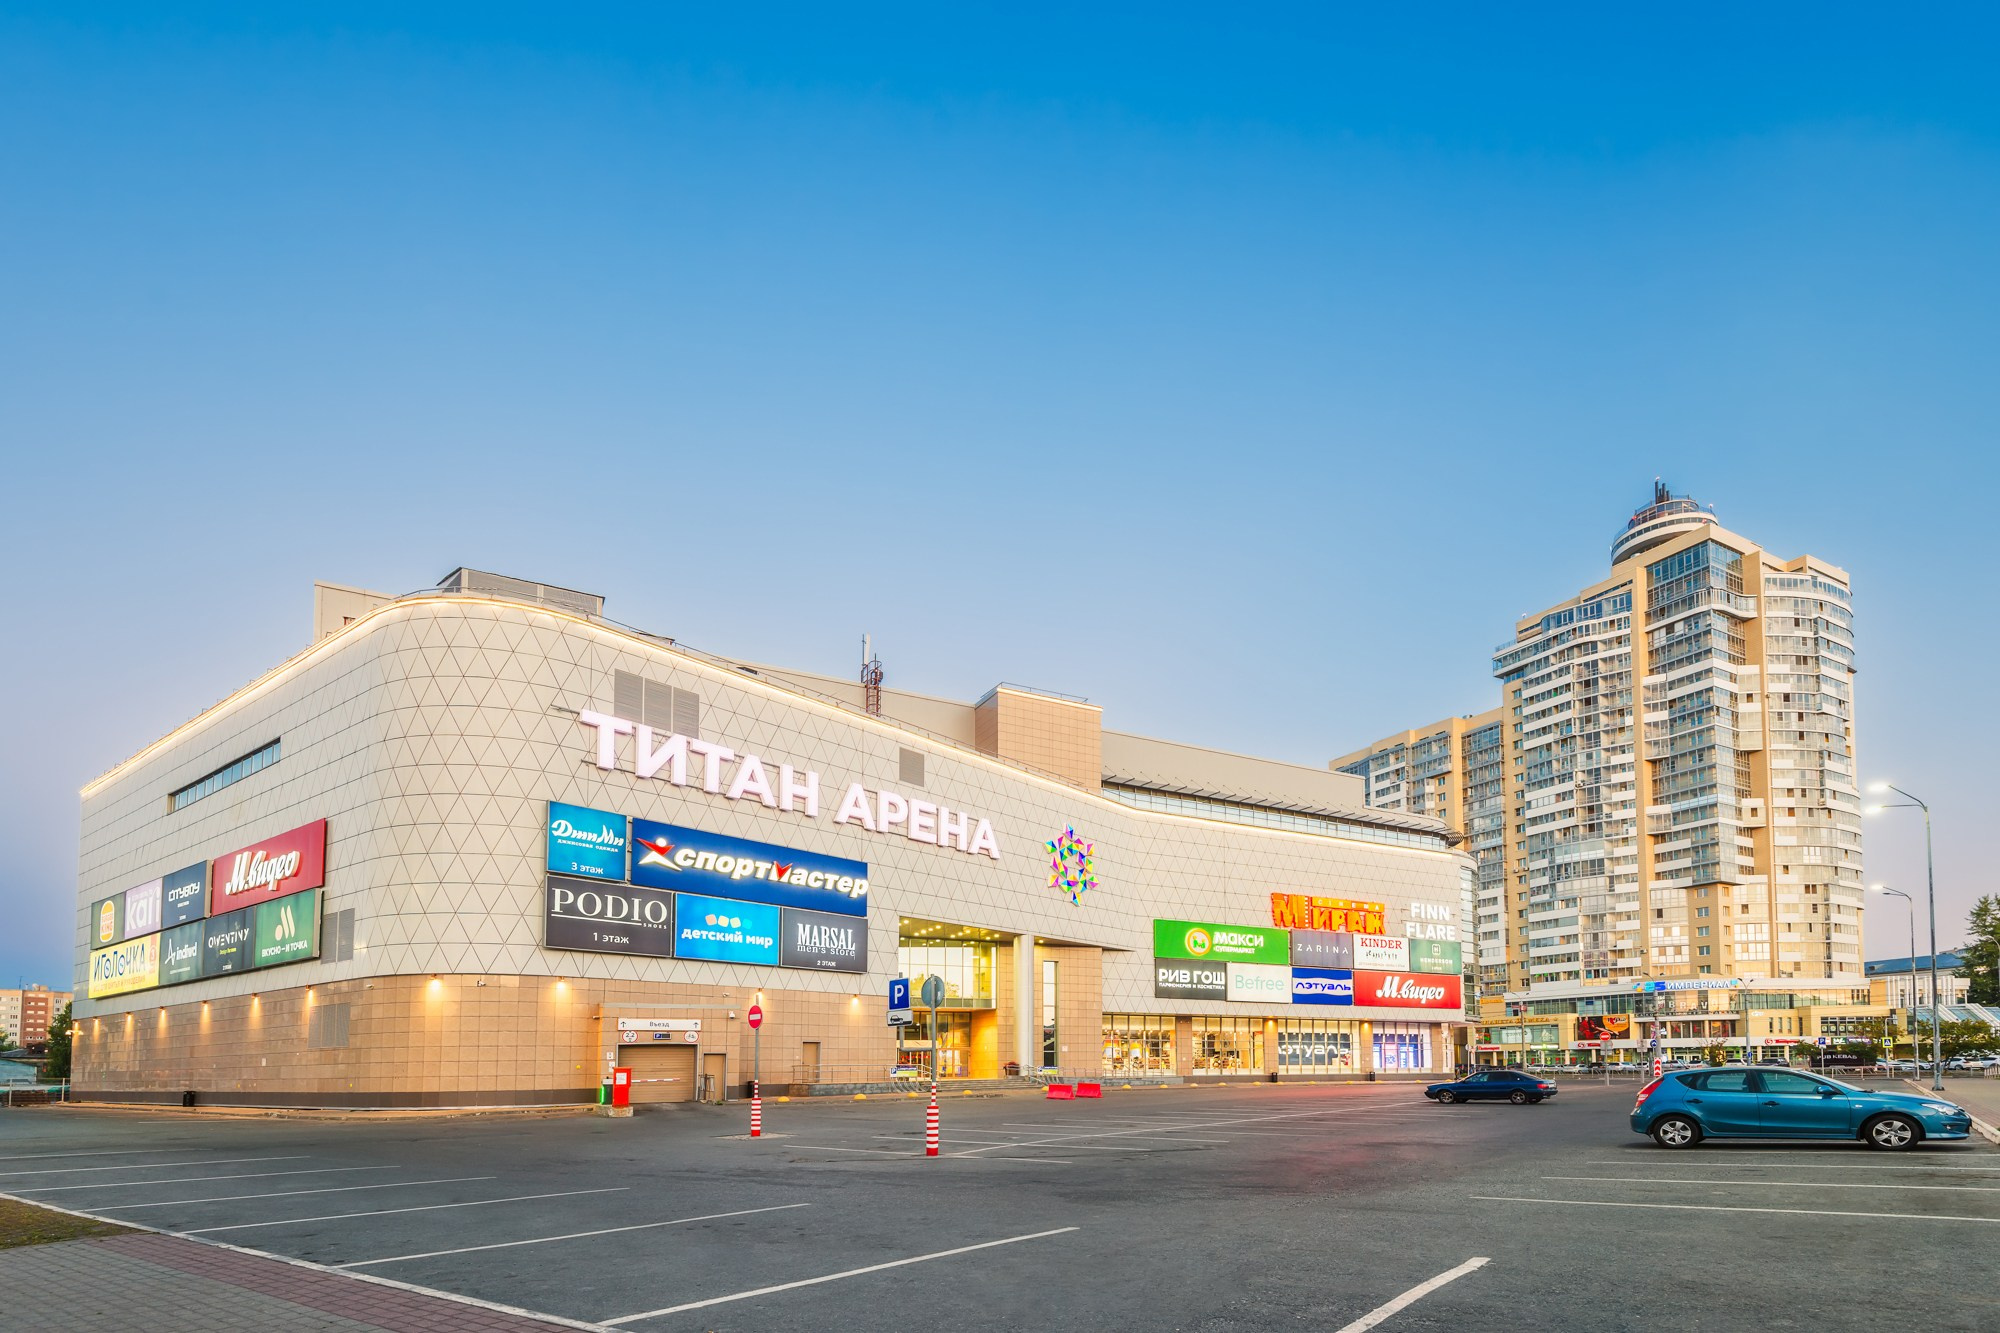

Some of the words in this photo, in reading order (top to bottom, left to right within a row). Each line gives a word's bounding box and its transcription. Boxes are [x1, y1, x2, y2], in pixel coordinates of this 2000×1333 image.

[579, 708, 819, 818] ТИТАН
[833, 782, 1001, 860] АРЕНА
[571, 861, 578, 871] 3
[580, 864, 604, 874] этаж
[551, 887, 668, 924] PODIO
[1318, 899, 1380, 911] CINEMA
[1410, 902, 1450, 921] FINN
[643, 922, 668, 930] SHOES
[1405, 921, 1456, 940] FLARE
[593, 932, 598, 942] 1
[602, 934, 630, 944] этаж
[681, 927, 743, 944] детский
[745, 934, 774, 950] мир
[797, 923, 856, 951] MARSAL
[1360, 937, 1403, 949] KINDER
[1296, 943, 1349, 955] ZARINA
[1158, 968, 1191, 983] РИВ
[1193, 970, 1225, 985] ГОШ
[1235, 974, 1285, 991] Befree
[894, 985, 905, 1005] P
[1375, 975, 1445, 1004] М.видео
